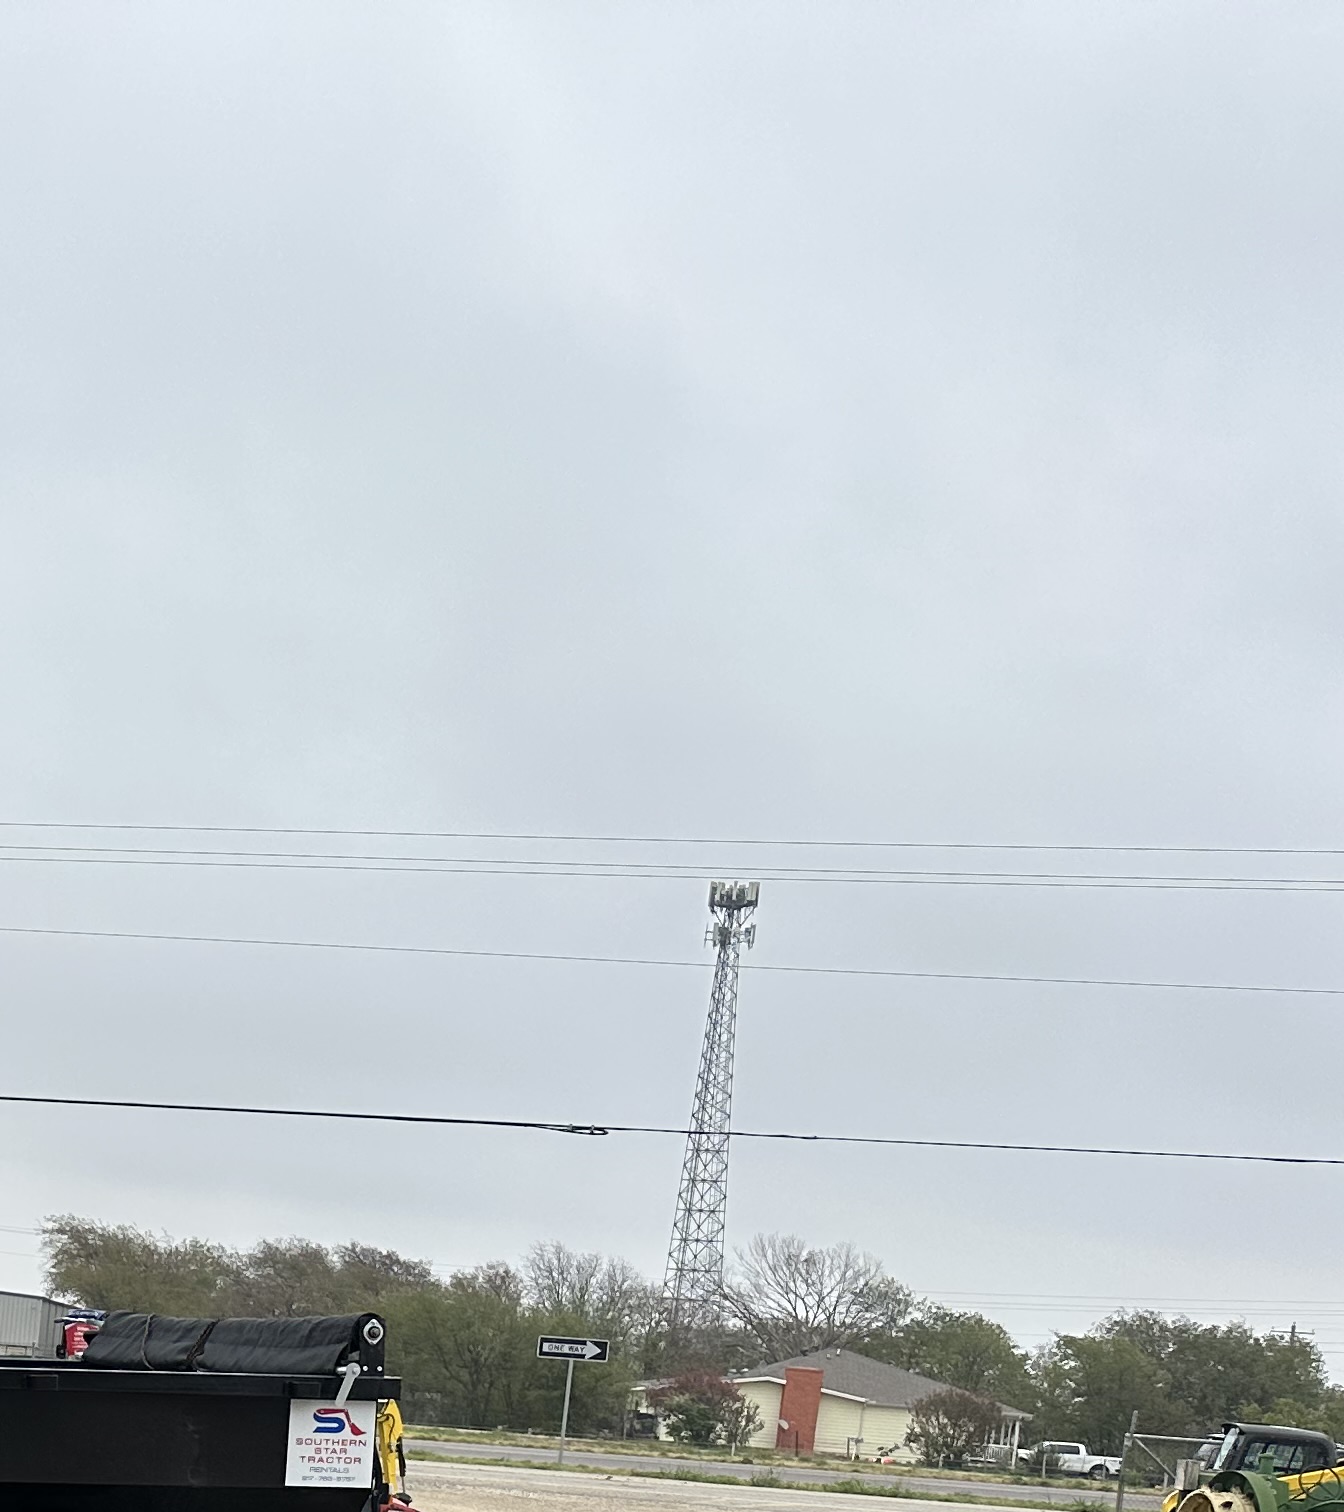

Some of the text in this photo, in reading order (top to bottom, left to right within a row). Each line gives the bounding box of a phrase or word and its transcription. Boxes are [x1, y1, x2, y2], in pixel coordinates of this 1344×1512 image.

[548, 1343, 585, 1353] ONE WAY
[295, 1437, 367, 1447] SOUTHERN
[314, 1447, 347, 1455] STAR
[299, 1455, 362, 1464] TRACTOR
[309, 1466, 349, 1474] RENTALS
